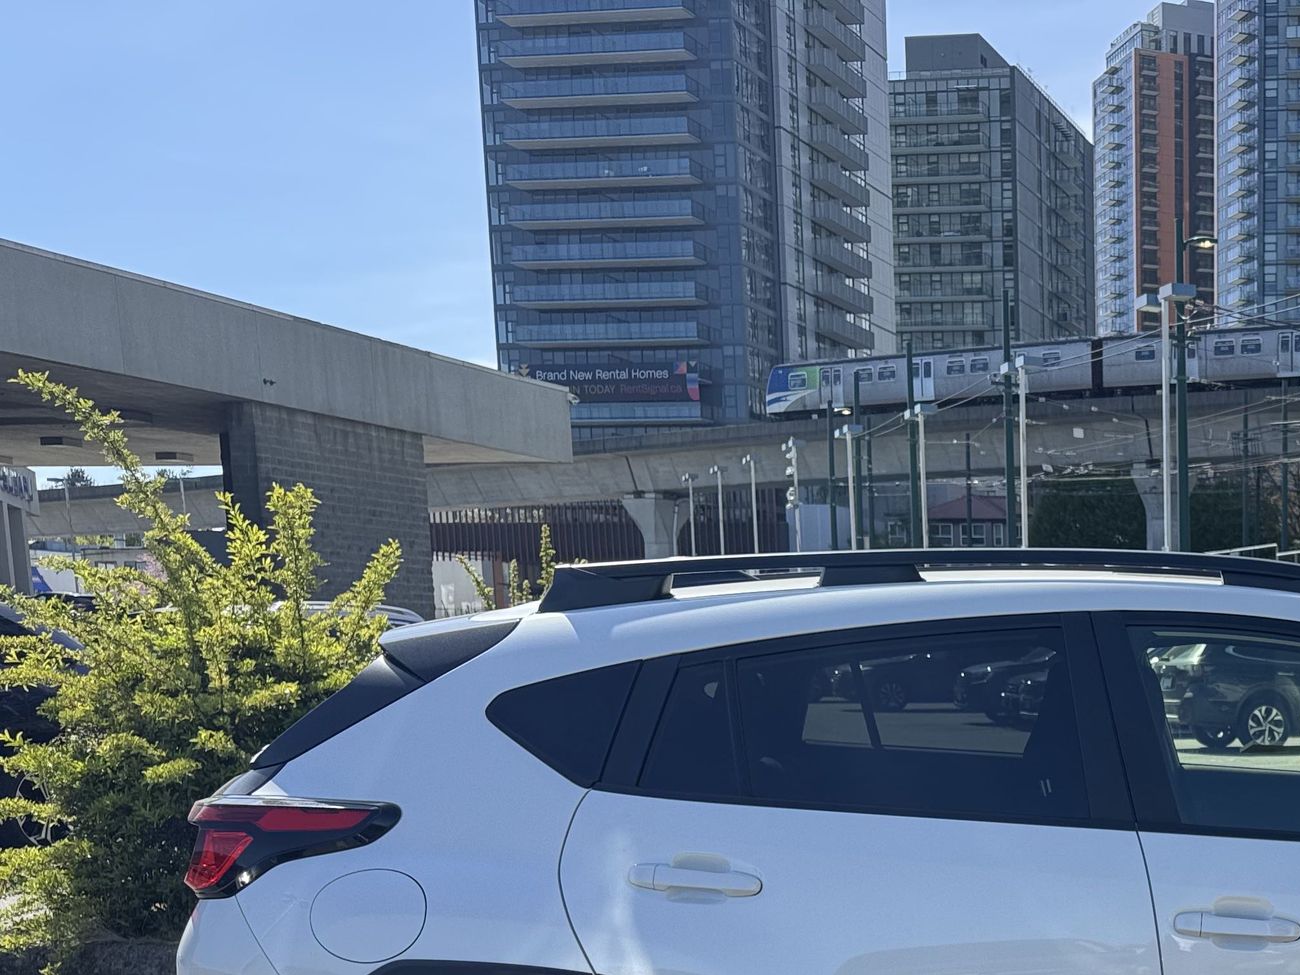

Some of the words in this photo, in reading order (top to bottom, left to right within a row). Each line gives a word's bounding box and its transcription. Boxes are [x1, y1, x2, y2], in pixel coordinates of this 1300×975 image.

[536, 369, 567, 381] Brand
[570, 369, 592, 381] New
[595, 368, 629, 380] Rental
[632, 368, 669, 380] Homes
[584, 384, 616, 395] TODAY
